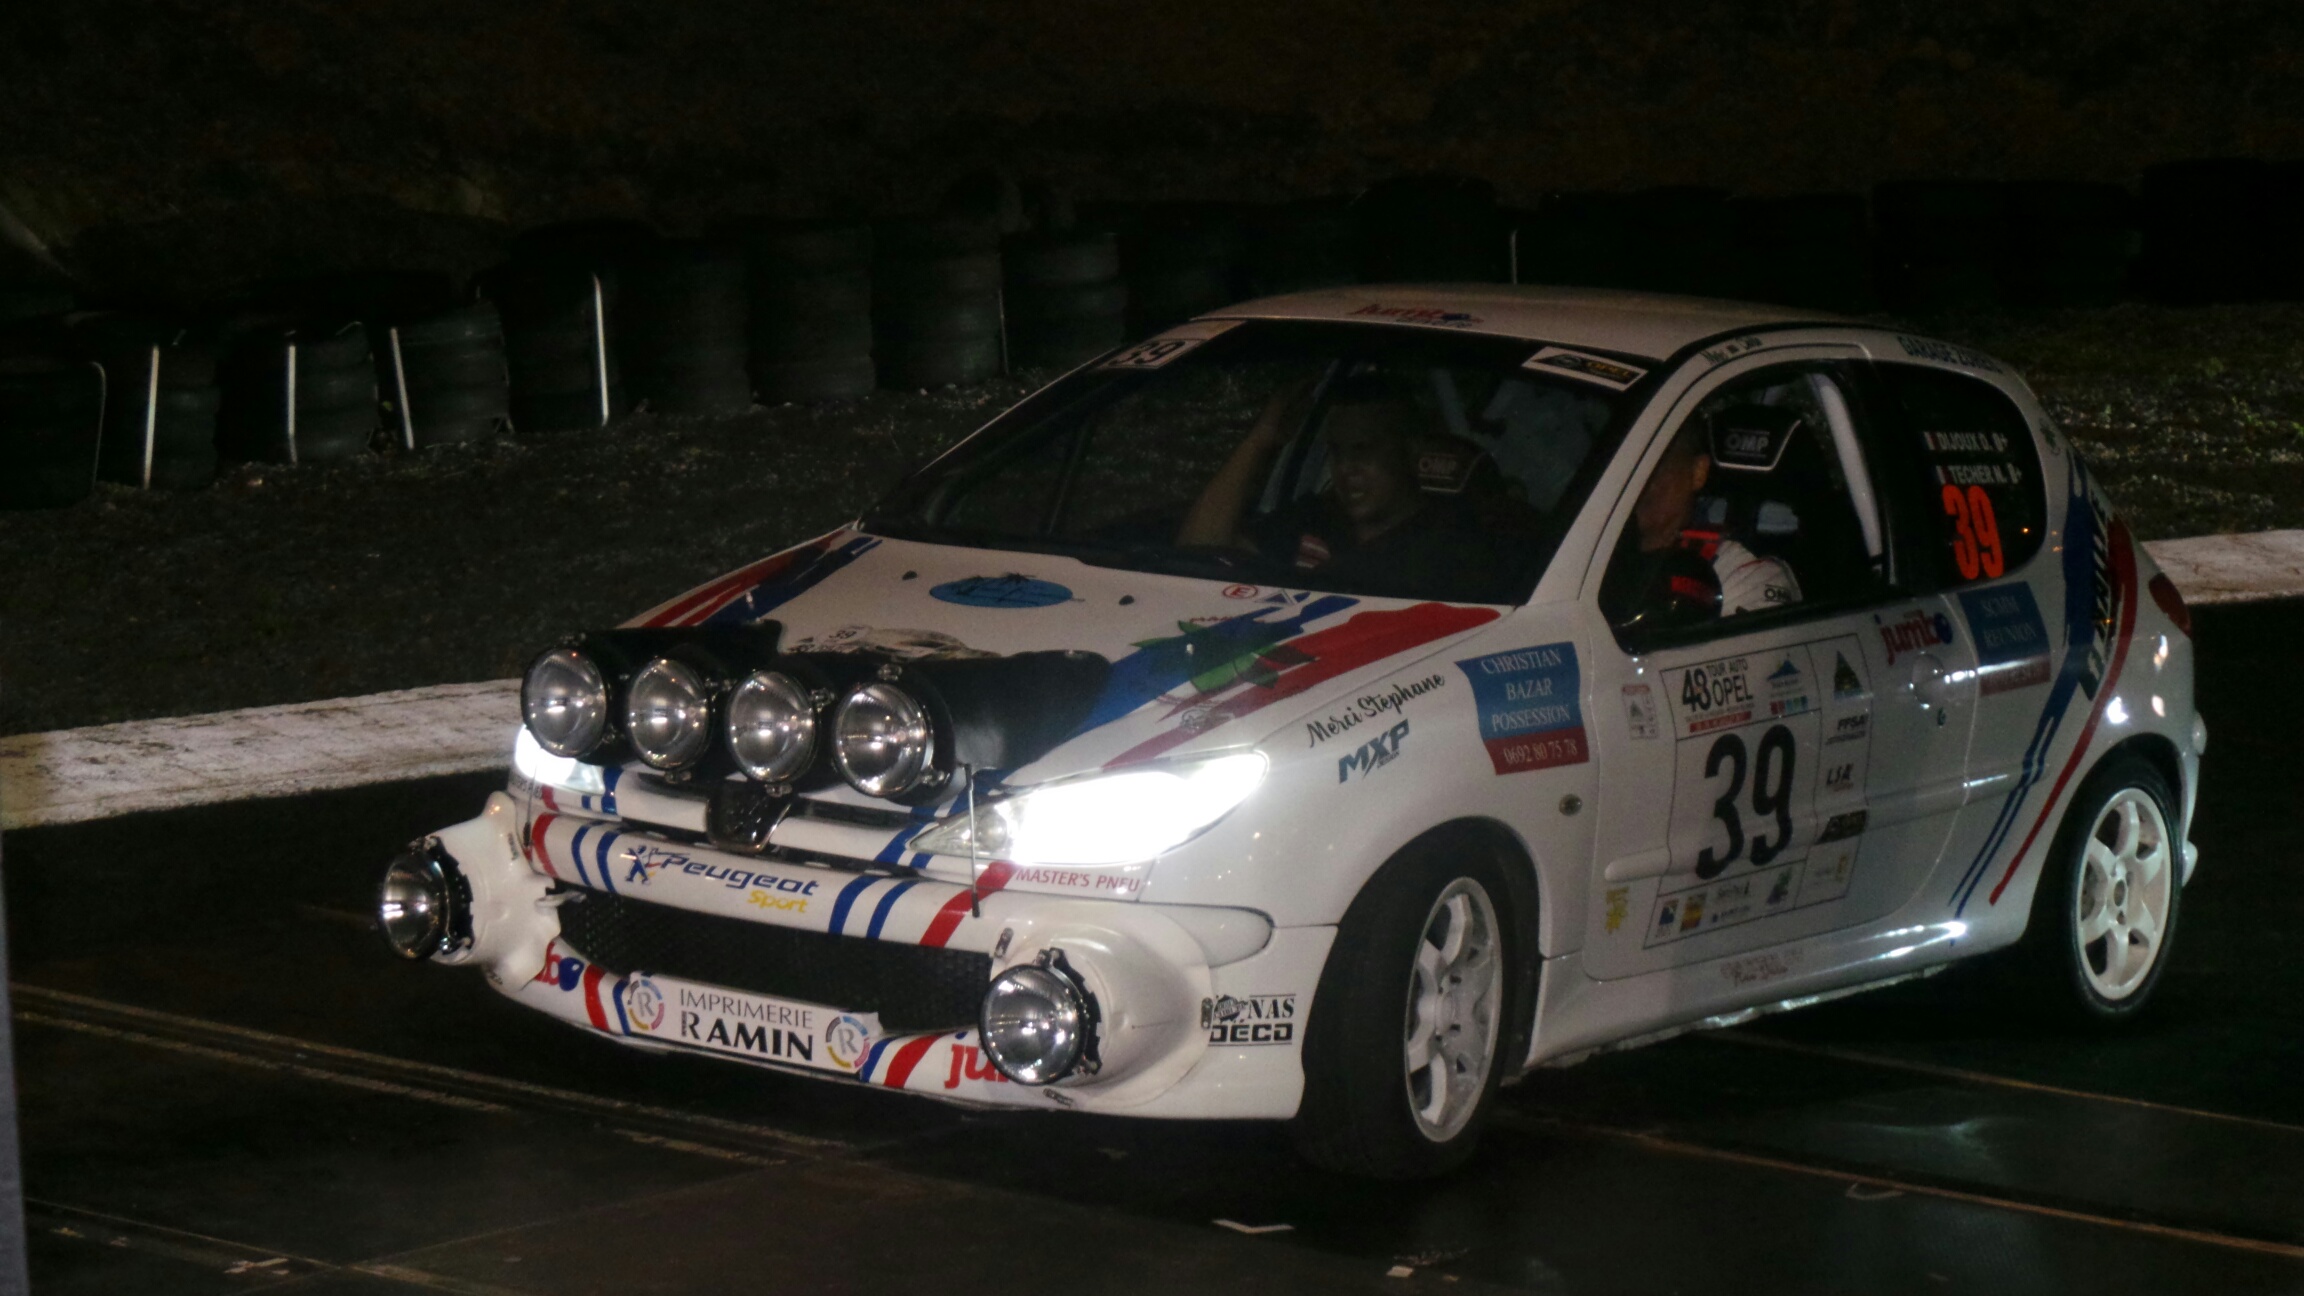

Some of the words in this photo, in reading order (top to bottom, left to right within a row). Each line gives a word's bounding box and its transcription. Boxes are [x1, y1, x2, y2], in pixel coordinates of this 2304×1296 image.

[1108, 340, 1186, 366] 39
[1724, 432, 1770, 452] OMP
[1941, 483, 2005, 581] 39
[1480, 647, 1562, 675] CHRISTIAN
[1504, 677, 1554, 702] BAZAR
[1682, 668, 1711, 712] 48
[1729, 658, 1749, 673] AUTO
[1712, 674, 1754, 706] OPEL
[1306, 706, 1363, 748] Merci
[1491, 703, 1571, 733] POSSESSION
[1338, 718, 1411, 785] MXP
[1503, 744, 1532, 766] 0692
[1532, 743, 1547, 762] 80
[1549, 741, 1563, 760] 75
[1564, 738, 1578, 758] 78
[1695, 723, 1797, 880] 39
[660, 855, 820, 896] Peugeot
[1016, 867, 1091, 888] MASTER'S
[1095, 874, 1141, 893] PNEU
[679, 988, 814, 1030] IMPRIMERIE
[681, 1011, 814, 1062] RAMIN
